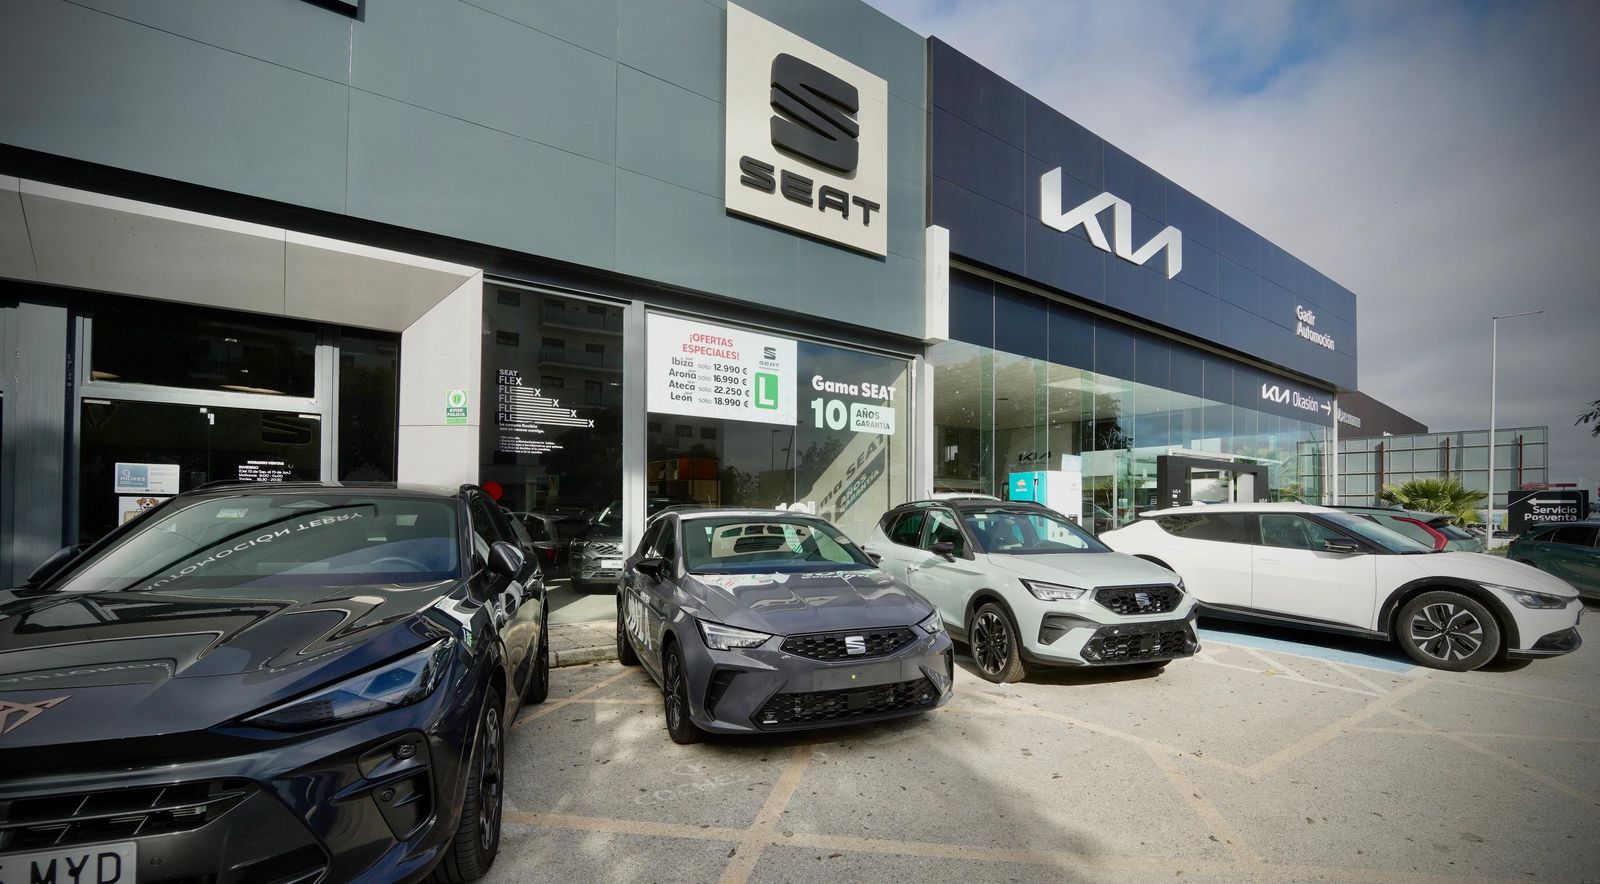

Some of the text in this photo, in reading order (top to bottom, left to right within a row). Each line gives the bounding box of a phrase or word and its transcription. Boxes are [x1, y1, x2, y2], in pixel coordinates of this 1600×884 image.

[739, 155, 880, 226] SEAT
[1041, 166, 1182, 280] KIA
[1296, 305, 1316, 326] Gadir
[690, 333, 734, 348] ¡OFERTAS
[1296, 321, 1335, 351] Automoción
[682, 344, 740, 360] ESPECIALES!
[672, 357, 694, 367] Ibiza
[714, 364, 740, 374] 12.990
[499, 376, 522, 385] FLEX
[669, 368, 696, 379] Arona
[713, 375, 739, 385] 16.990
[669, 380, 695, 391] Ateca
[714, 386, 742, 396] 22.250
[759, 376, 775, 406] L
[812, 374, 896, 400] Gama SEAT
[671, 392, 692, 402] León
[714, 397, 740, 407] 18.990
[1262, 383, 1318, 412] KIA Okasión
[811, 398, 848, 430] 10
[856, 408, 880, 420] AÑOS
[856, 420, 890, 430] GARANTÍA
[30, 852, 121, 884] MYD
